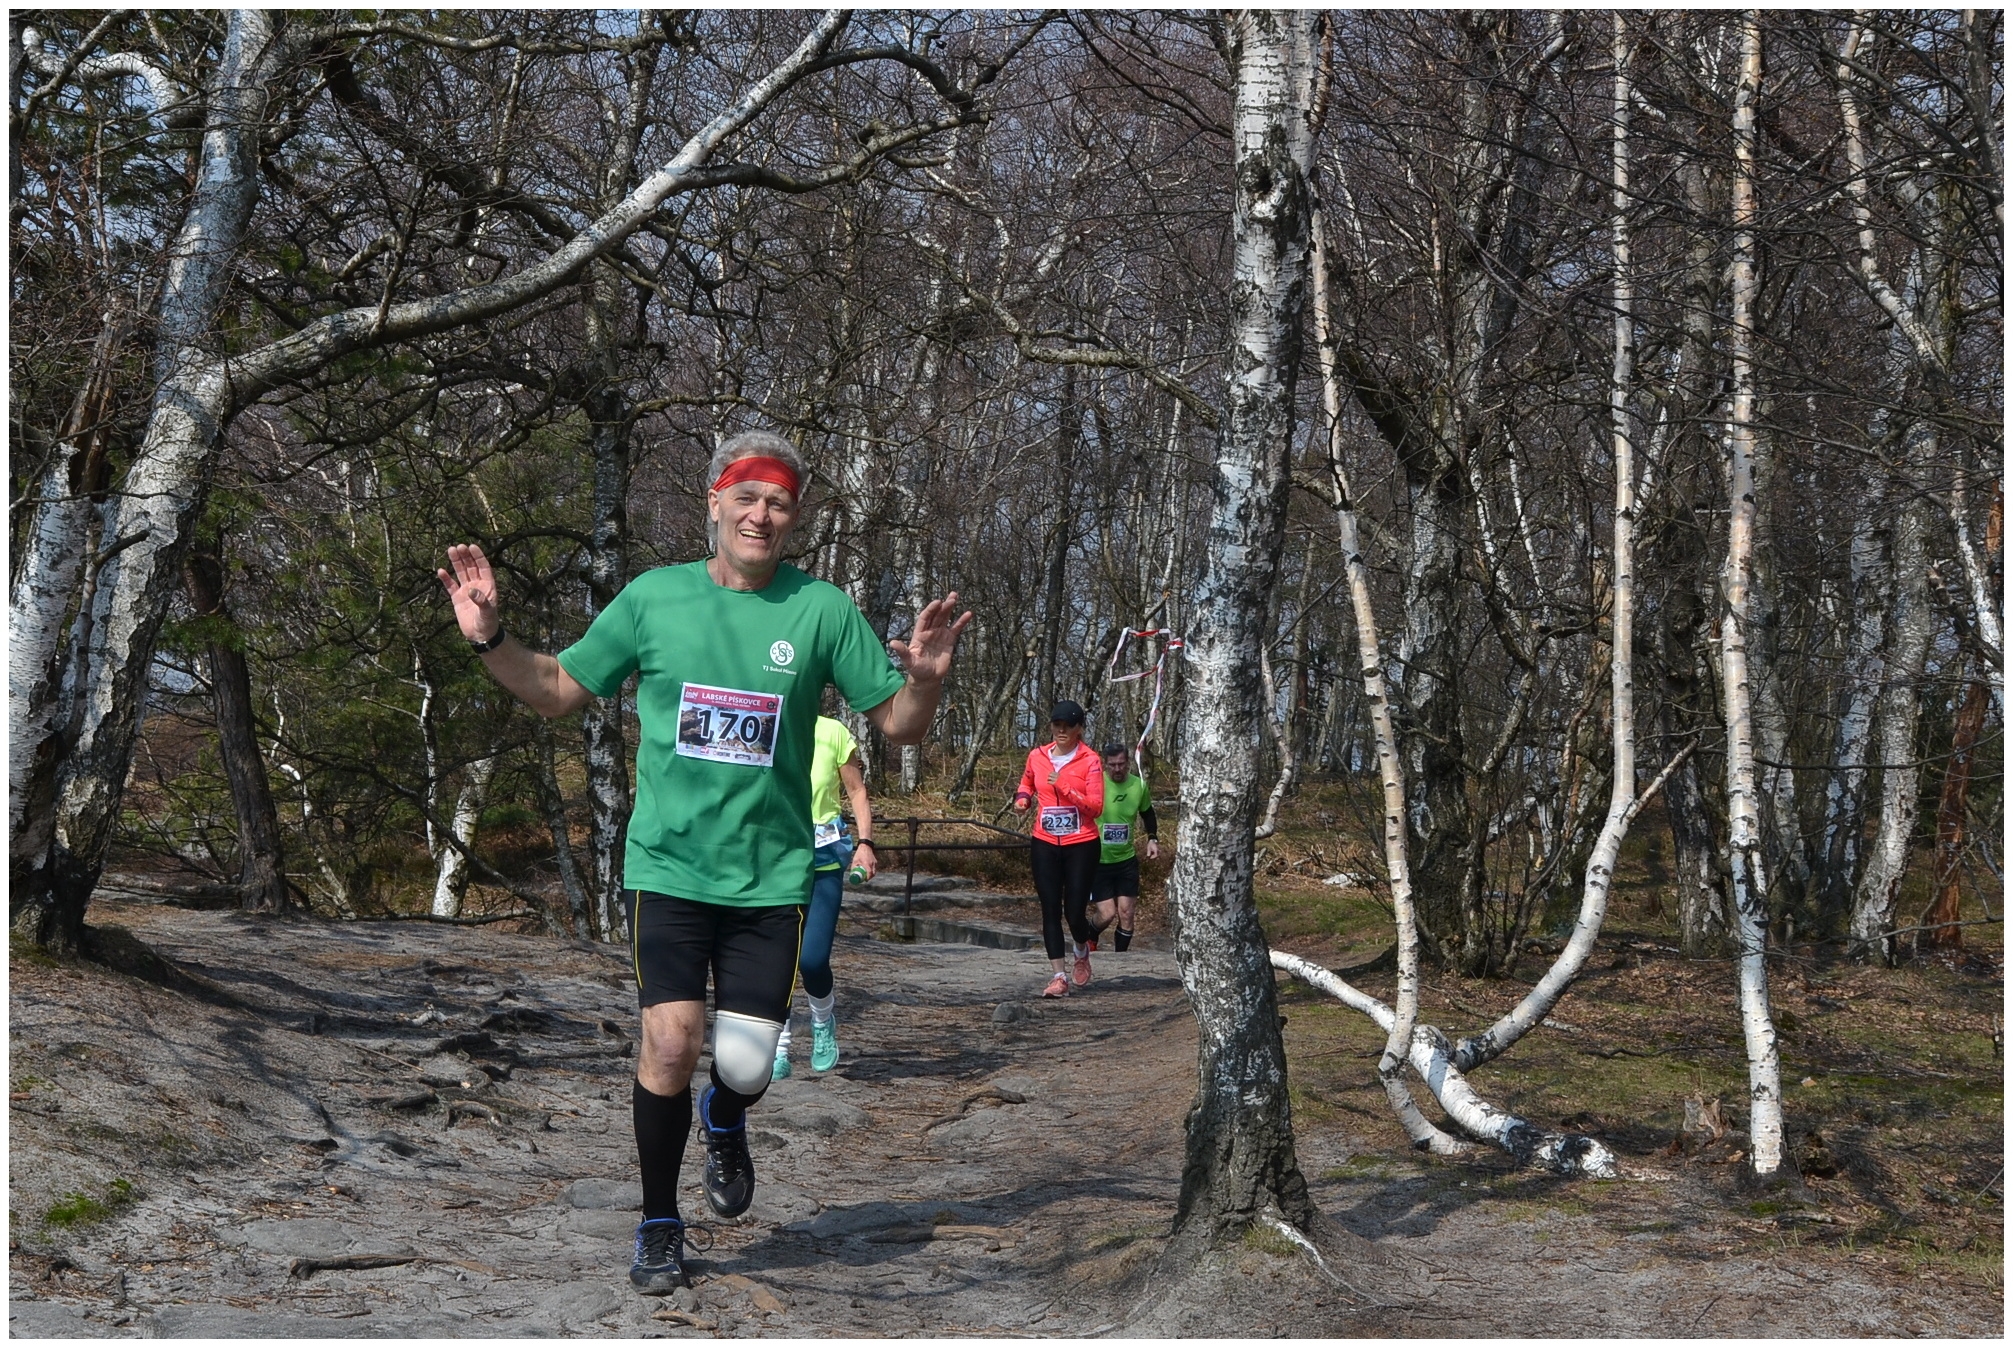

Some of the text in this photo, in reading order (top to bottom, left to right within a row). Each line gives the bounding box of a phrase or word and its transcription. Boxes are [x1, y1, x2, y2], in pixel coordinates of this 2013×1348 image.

[702, 692, 727, 702] LABSKÉ
[728, 695, 761, 706] PÍSKOVCE
[699, 709, 761, 743] 170
[1047, 816, 1072, 827] 222
